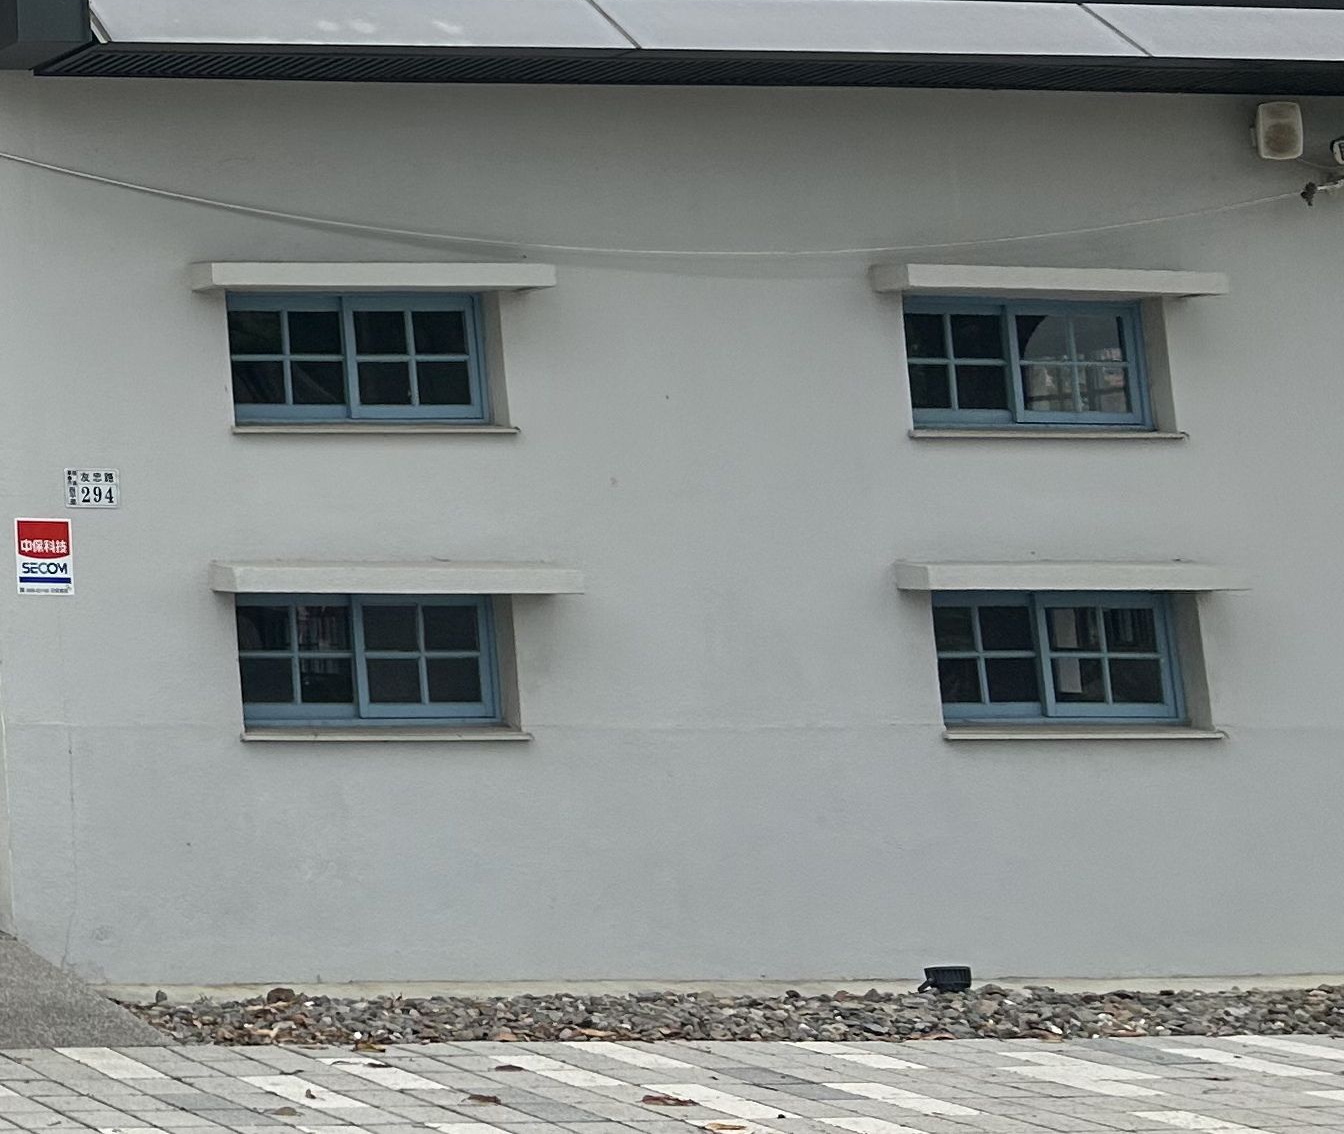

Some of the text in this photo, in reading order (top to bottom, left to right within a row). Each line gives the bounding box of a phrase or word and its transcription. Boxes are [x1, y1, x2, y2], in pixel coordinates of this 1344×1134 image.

[81, 486, 114, 503] 294
[20, 538, 68, 554] 中保科技
[22, 562, 68, 574] SECOM
